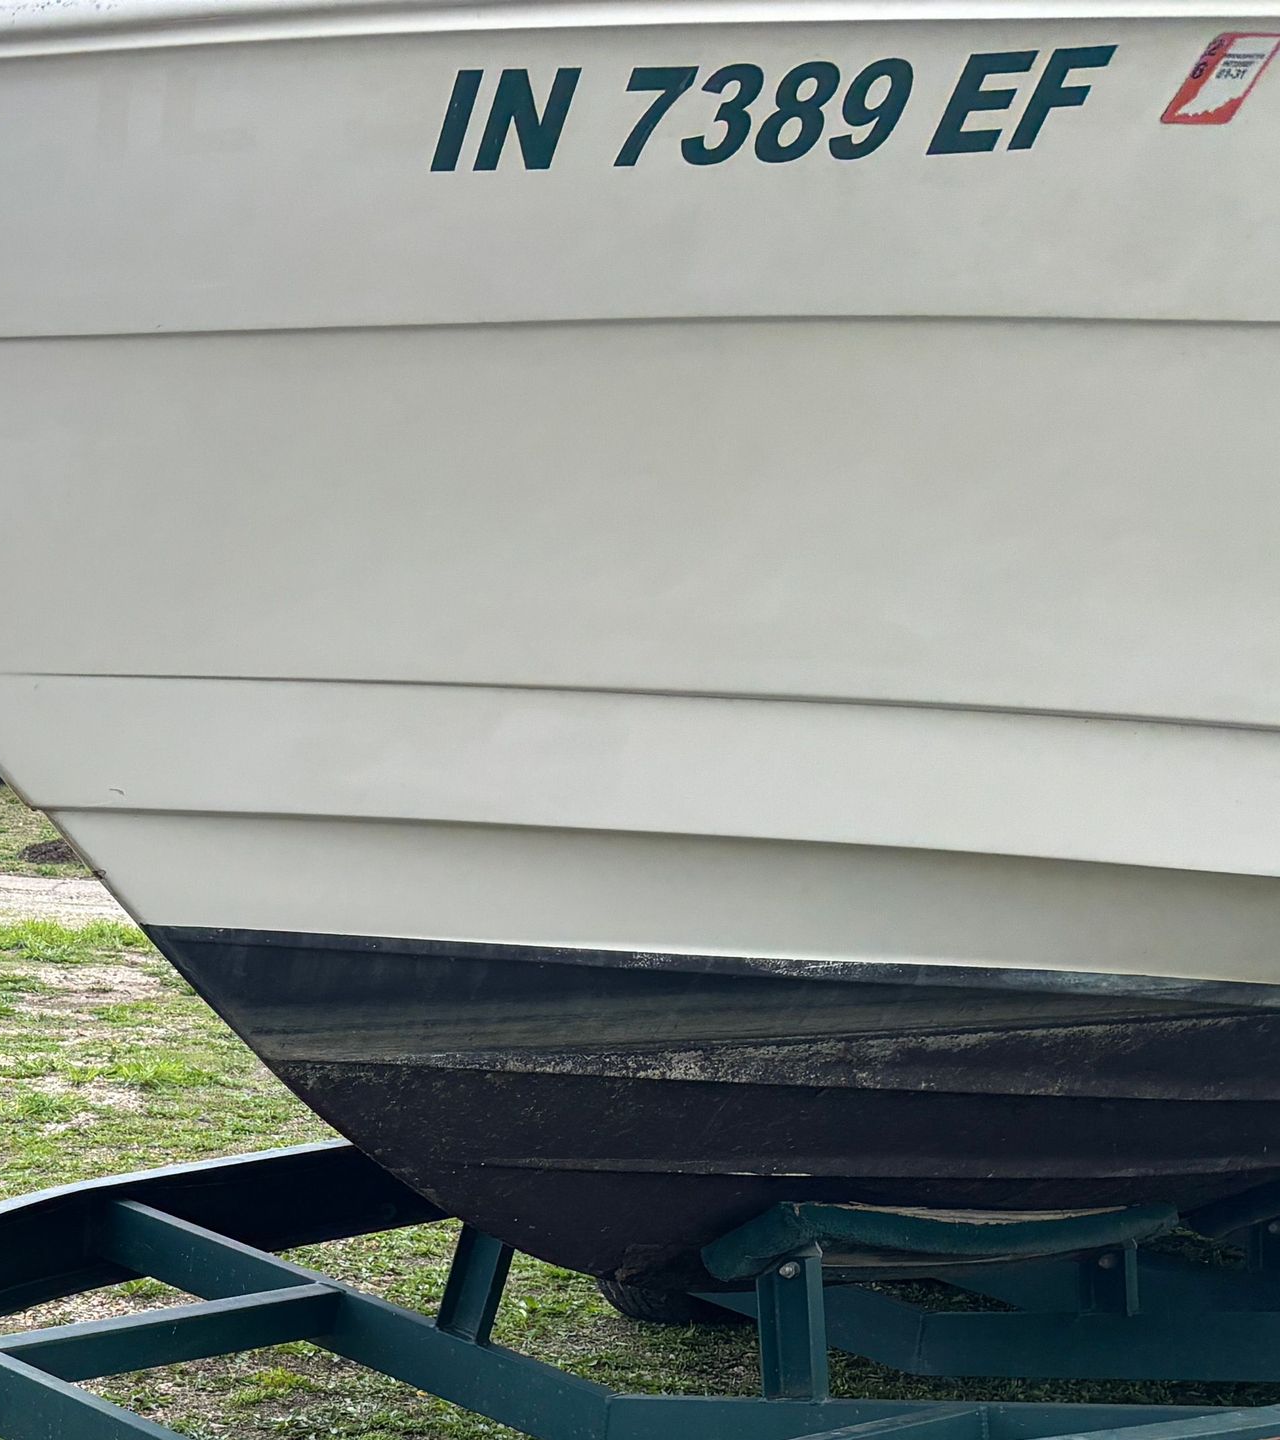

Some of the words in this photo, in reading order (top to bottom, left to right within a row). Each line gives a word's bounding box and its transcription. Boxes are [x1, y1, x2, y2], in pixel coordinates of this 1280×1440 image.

[430, 66, 582, 171] IN
[612, 56, 914, 168] 7389
[925, 44, 1120, 156] EF
